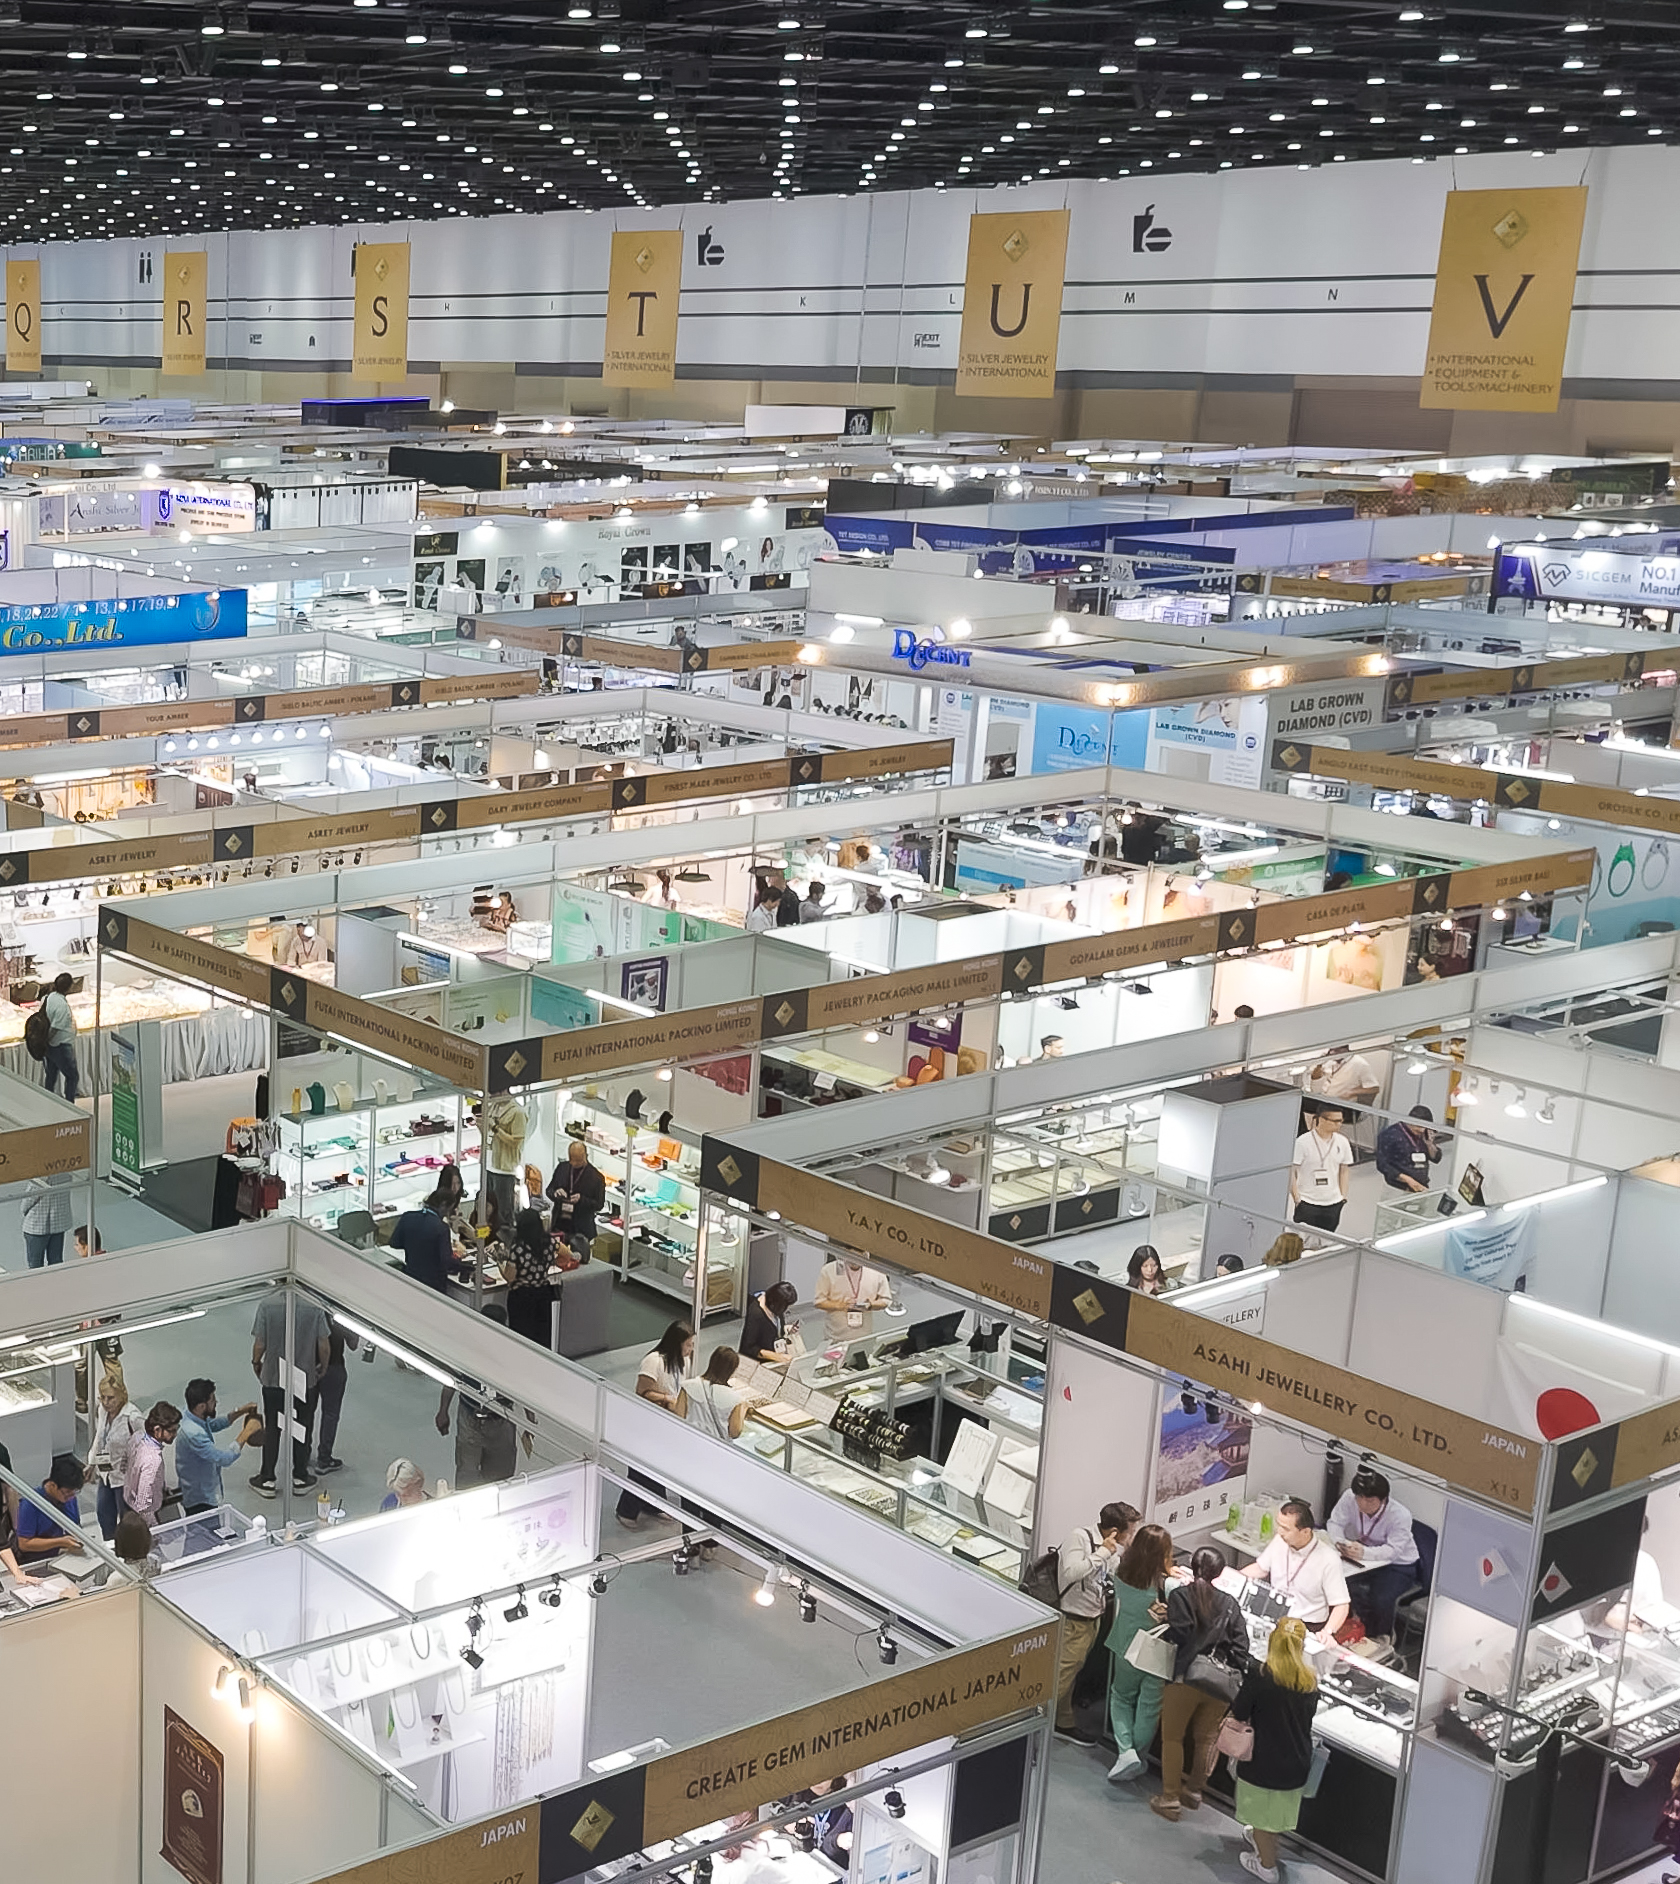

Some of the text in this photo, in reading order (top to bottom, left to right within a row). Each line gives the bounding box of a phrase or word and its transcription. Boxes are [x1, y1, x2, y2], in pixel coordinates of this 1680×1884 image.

[799, 296, 806, 307] K
[949, 293, 956, 305] L
[1124, 291, 1136, 304] M
[1327, 289, 1338, 301] N
[176, 300, 193, 335] R
[371, 296, 389, 337] S
[627, 291, 658, 337] T
[990, 284, 1033, 337] U
[1473, 274, 1536, 339] V
[14, 302, 31, 342] Q
[610, 362, 672, 373] INTERNATIONAL
[966, 353, 1049, 364] SILVER JEWELRY
[1436, 355, 1536, 366] INTERNATIONAL
[966, 367, 1049, 378] INTERNATIONAL
[1435, 369, 1507, 379] EQUIPMENT
[1435, 382, 1554, 393] TOOLS/MACHINERY
[1576, 569, 1631, 584] SICGEM
[1290, 692, 1364, 713] LAB GROWN
[1156, 722, 1236, 738] LAB GROWN DIAMOND
[1278, 709, 1372, 733] DIAMOND (CVD)
[335, 823, 370, 836] JEWELRY
[119, 849, 157, 862] JEWELRY
[1071, 935, 1194, 965] GOPALAM GEMS JEWELLERY
[823, 971, 989, 1012] JEWELRY PACKAGING MALL LIMITED
[337, 1008, 401, 1043] INTERNATIONAL
[402, 1033, 440, 1057] PACKING
[441, 1048, 474, 1070] LIMITED
[553, 1016, 752, 1063] FUTAI INTERNATIONAL PACKING LIMITED
[54, 1125, 83, 1139] JAPAN
[887, 1225, 914, 1248] CO.,
[920, 1237, 948, 1260] LTD.
[1012, 1256, 1045, 1276] JAPAN
[980, 1280, 1040, 1311] W14,16,18
[1193, 1344, 1453, 1455] ASAHI JEWELLERY CO., LTD.
[1480, 1433, 1527, 1459] JAPAN
[1488, 1479, 1521, 1501] X13
[1010, 1634, 1048, 1659] JAPAN
[1017, 1682, 1045, 1703] X09
[685, 1665, 1022, 1801] CREATE GEM INTERNATIONAL JAPAN
[480, 1818, 527, 1848] JAPAN
